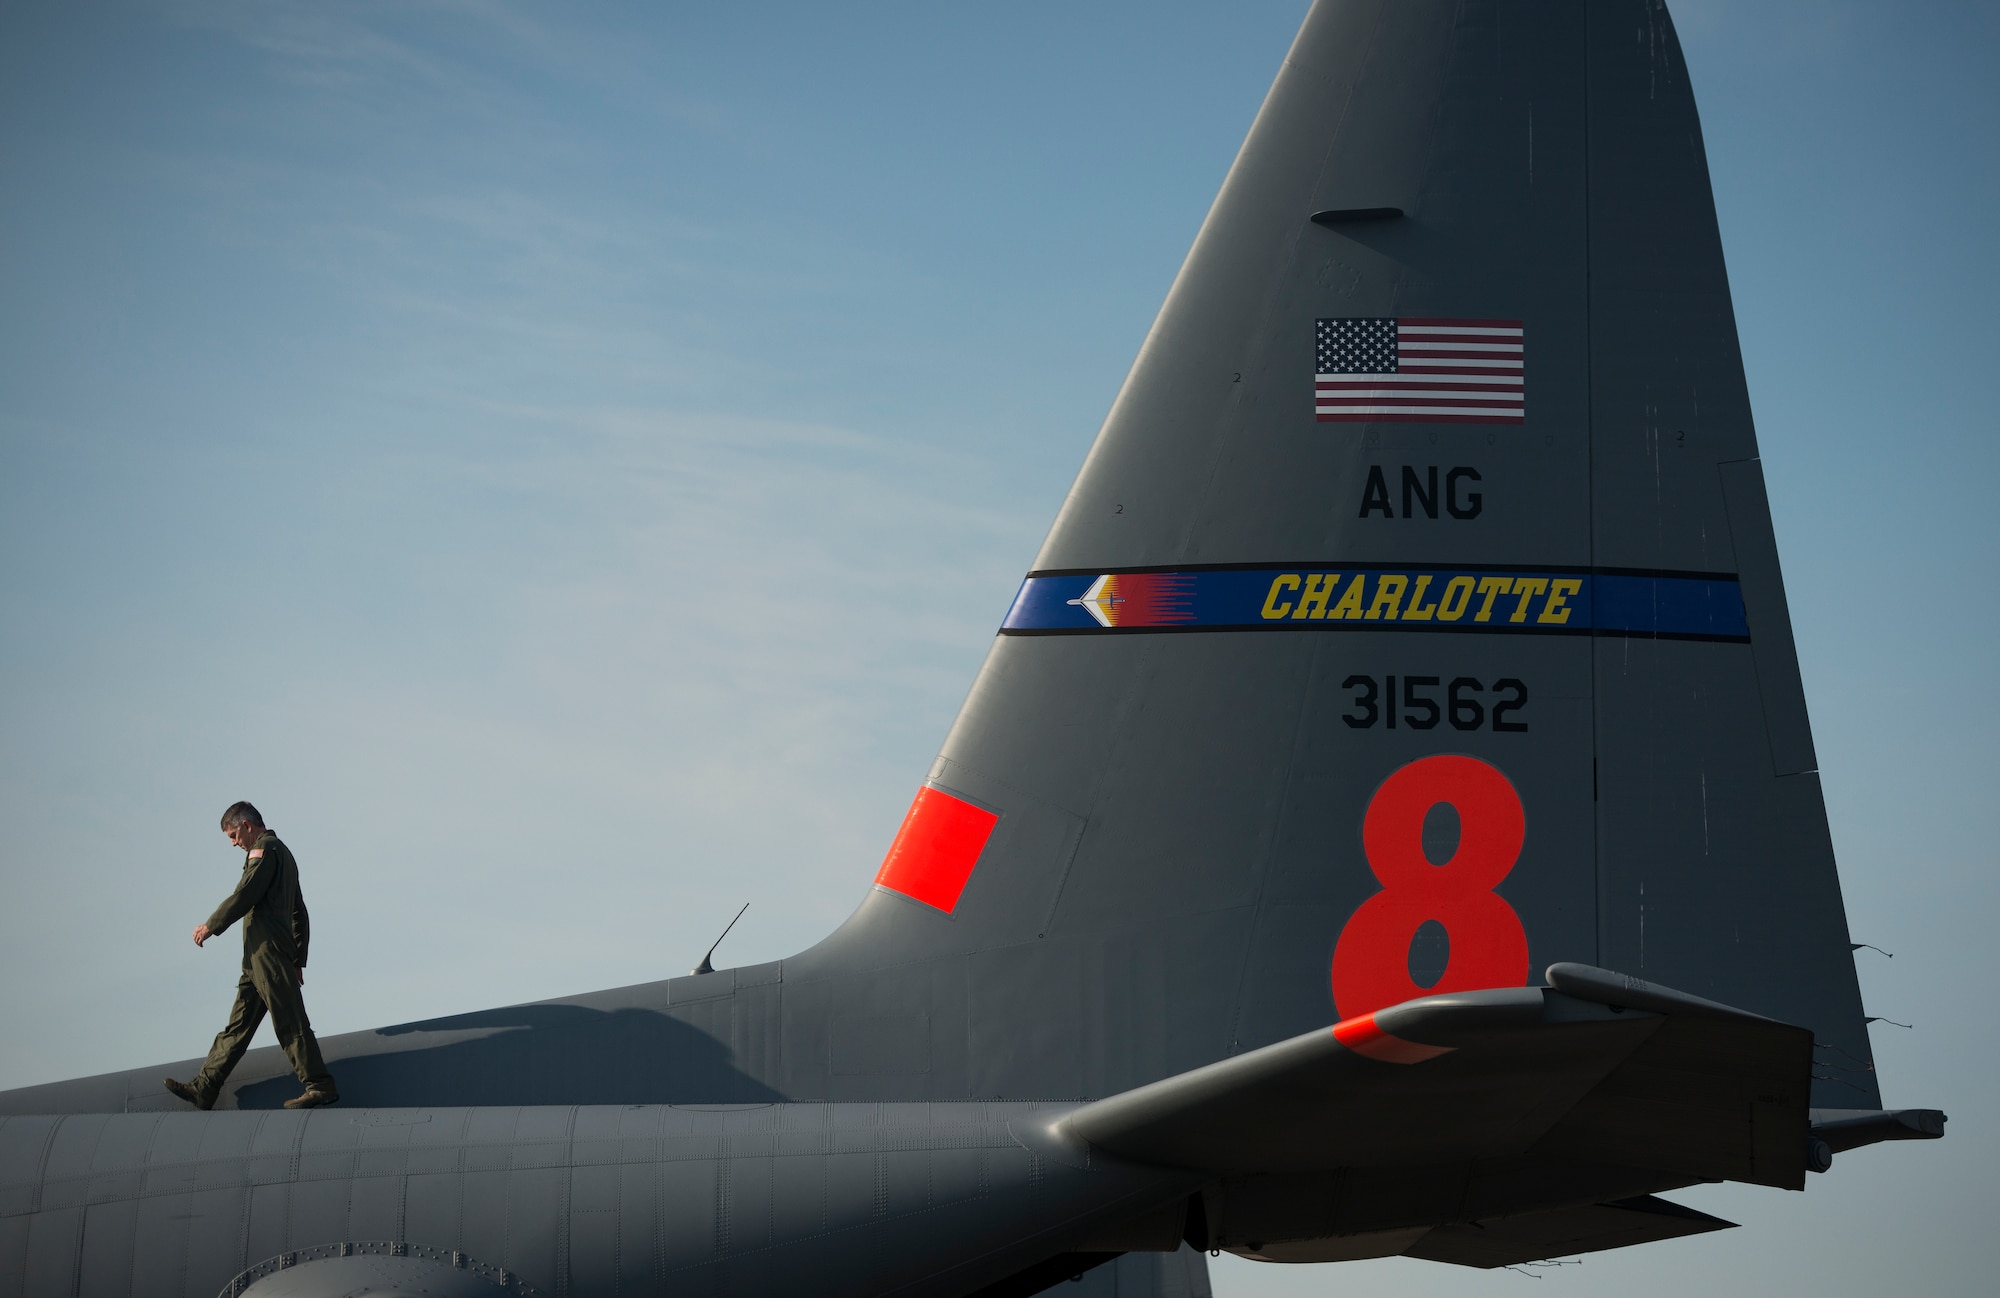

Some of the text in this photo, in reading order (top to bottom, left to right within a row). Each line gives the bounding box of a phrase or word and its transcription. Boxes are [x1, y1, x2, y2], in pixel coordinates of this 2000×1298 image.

[1232, 372, 1241, 383] 2
[1676, 430, 1685, 441] 2
[1115, 504, 1124, 515] 2
[1358, 465, 1483, 520] ANG
[1260, 573, 1583, 625] CHARLOTTE
[1341, 675, 1529, 733] 31562
[1331, 754, 1530, 1022] 8
